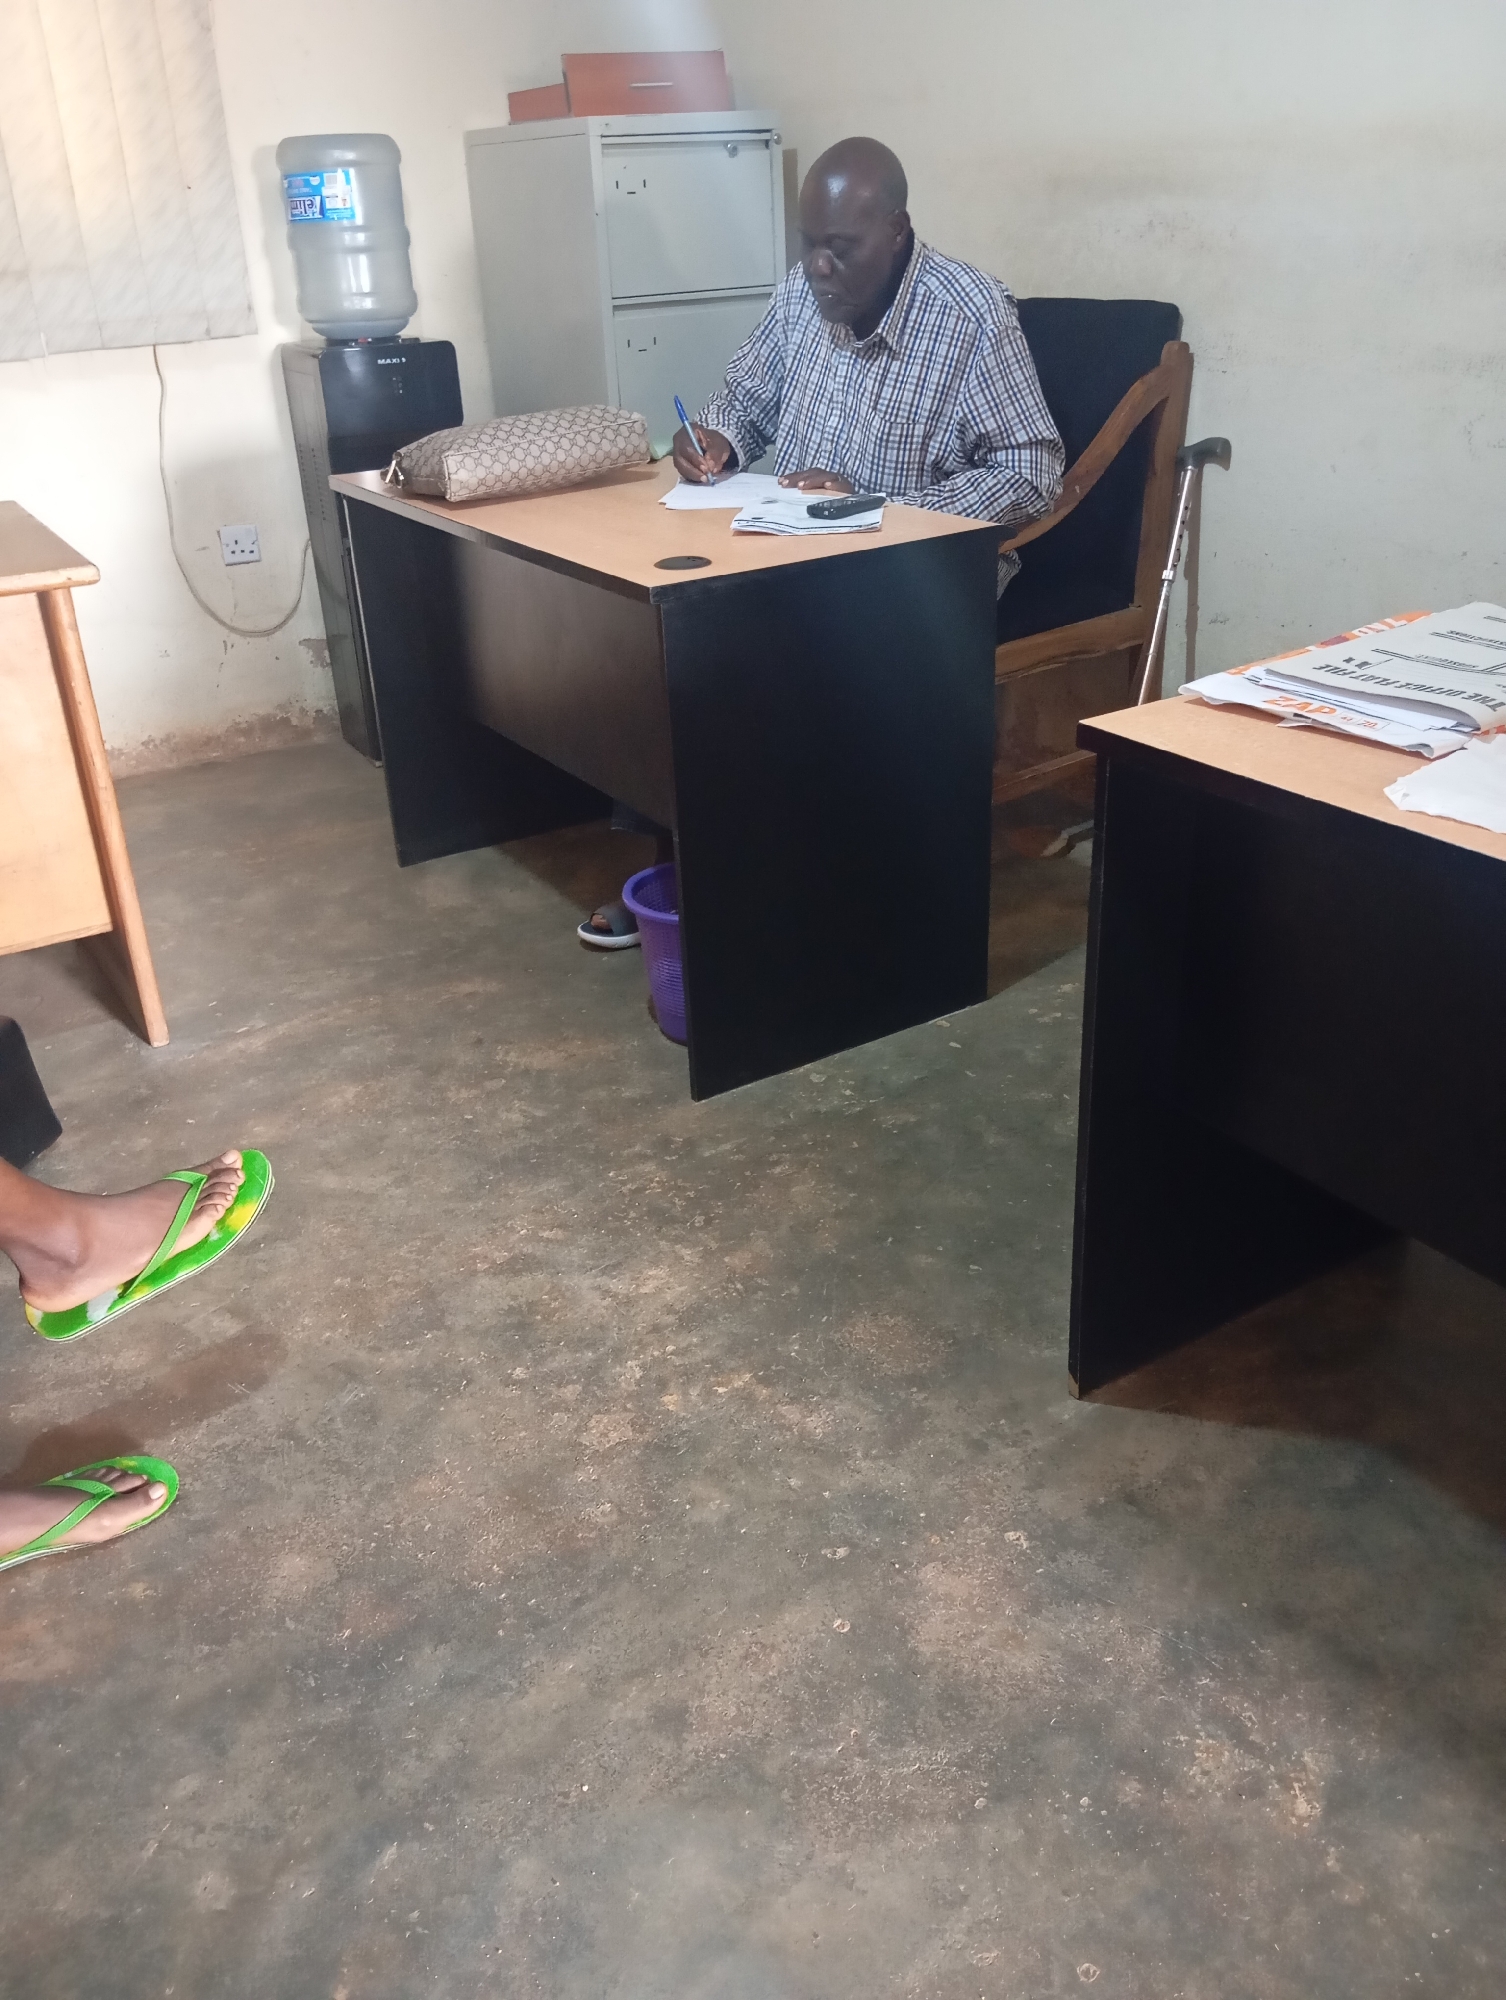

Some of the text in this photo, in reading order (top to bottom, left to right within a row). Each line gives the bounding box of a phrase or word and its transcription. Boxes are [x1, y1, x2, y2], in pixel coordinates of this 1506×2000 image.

[1312, 664, 1352, 677] FILE
[1349, 673, 1397, 687] FLAT
[1395, 681, 1467, 701] OFFICE
[1262, 695, 1338, 715] ZAP
